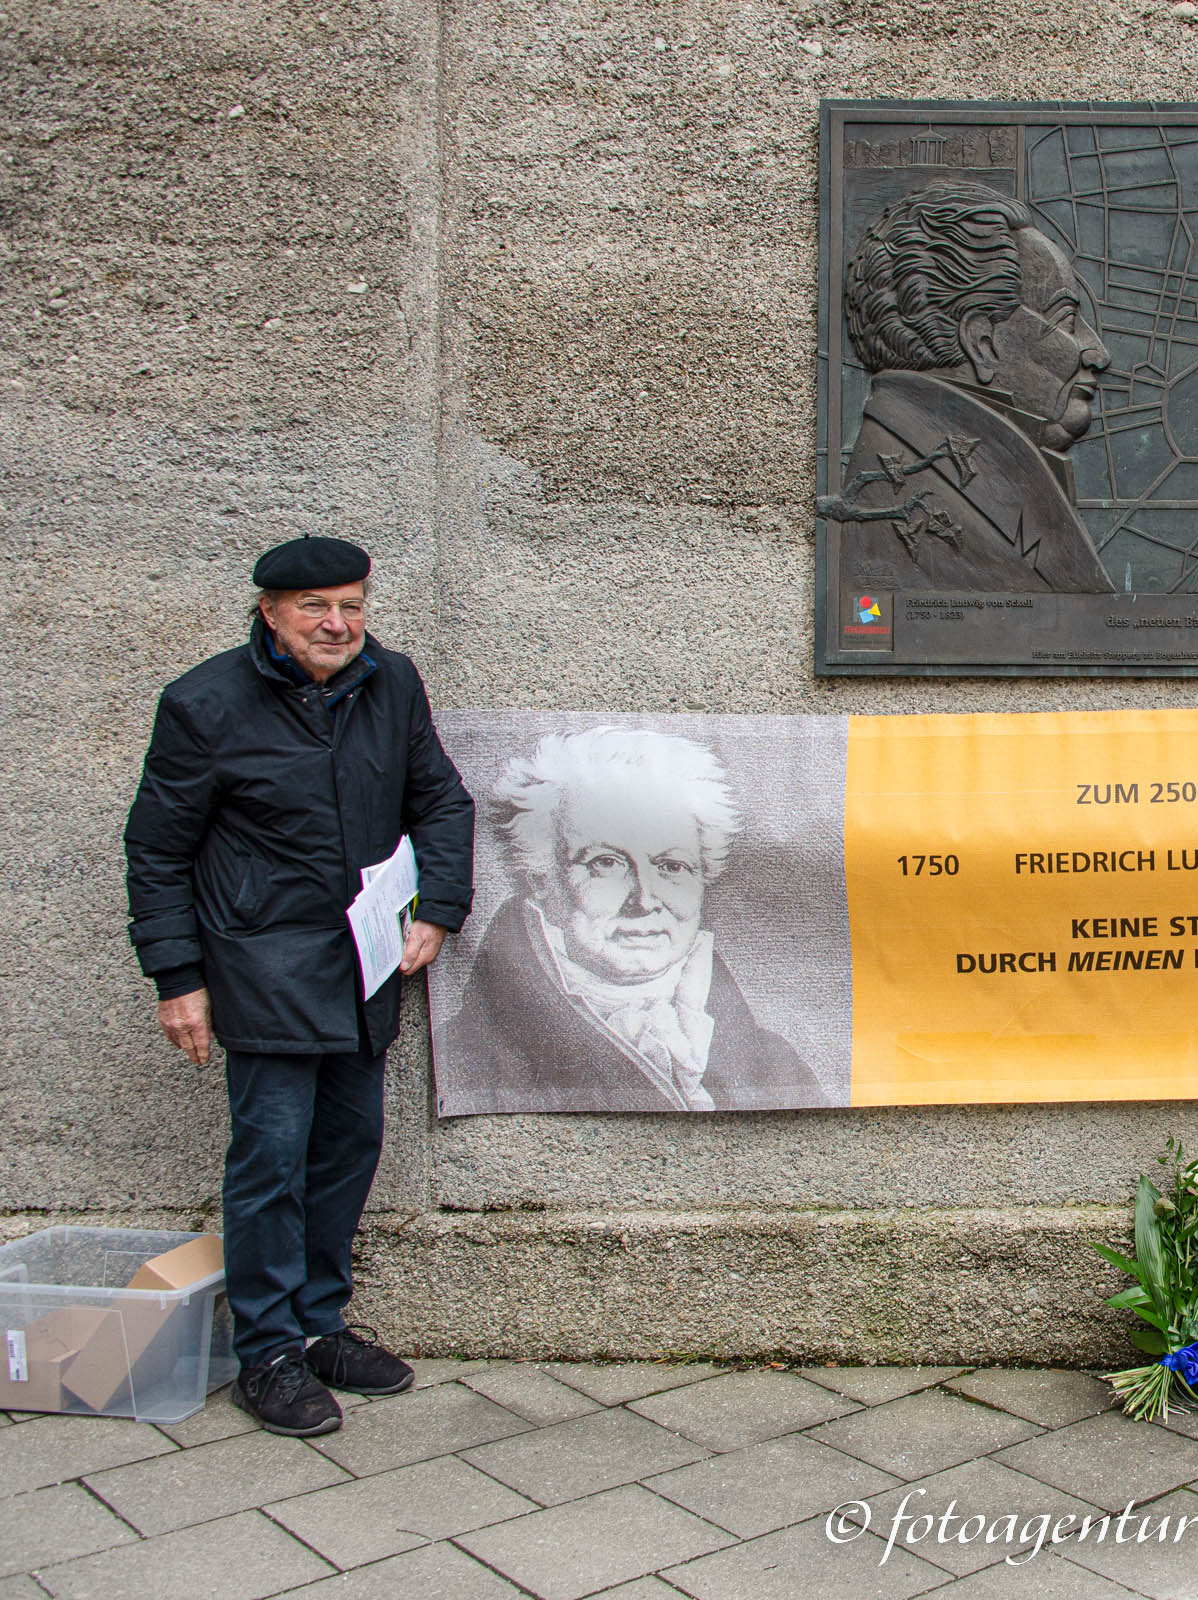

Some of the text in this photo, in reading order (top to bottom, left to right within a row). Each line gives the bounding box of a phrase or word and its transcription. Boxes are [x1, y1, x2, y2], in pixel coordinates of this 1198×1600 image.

[905, 599, 1034, 609] Friedrich Ludwig von Sckell
[1105, 616, 1130, 628] des
[1132, 616, 1183, 630] „neuen
[1076, 783, 1139, 805] ZUM
[897, 854, 959, 876] 1750
[1015, 850, 1155, 874] FRIEDRICH
[1071, 917, 1158, 939] KEINE
[956, 951, 1057, 974] DURCH
[1067, 949, 1185, 972] MEINEN
